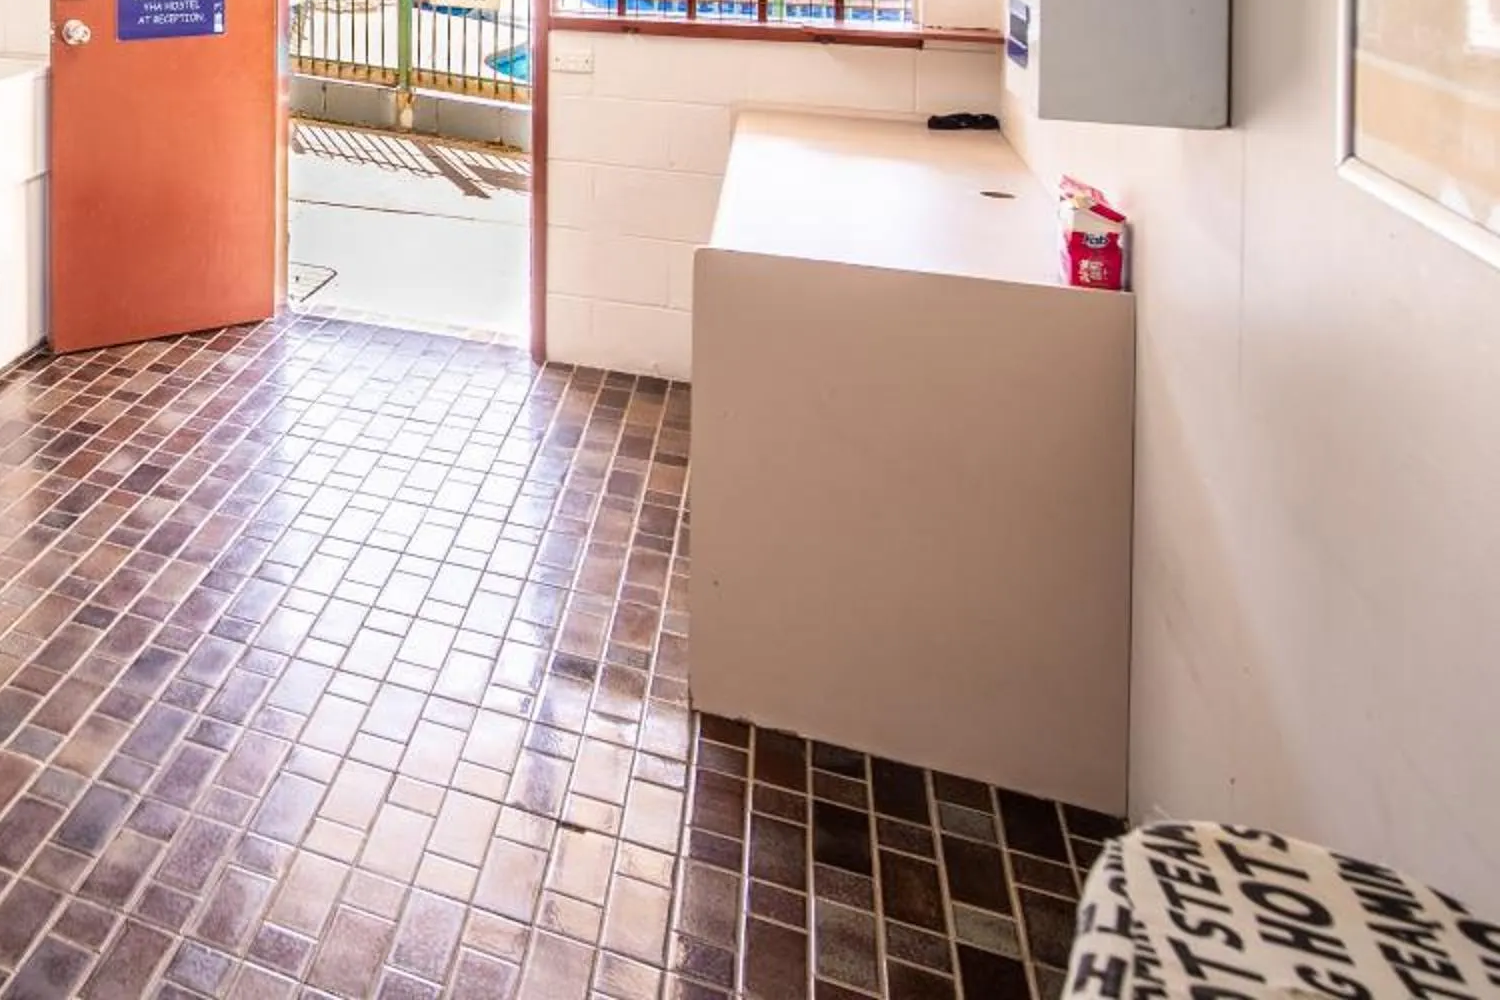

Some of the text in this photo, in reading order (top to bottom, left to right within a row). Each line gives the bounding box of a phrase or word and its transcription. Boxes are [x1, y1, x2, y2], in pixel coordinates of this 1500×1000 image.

[143, 0, 200, 12] YHA HOSTEL
[137, 15, 152, 24] AT
